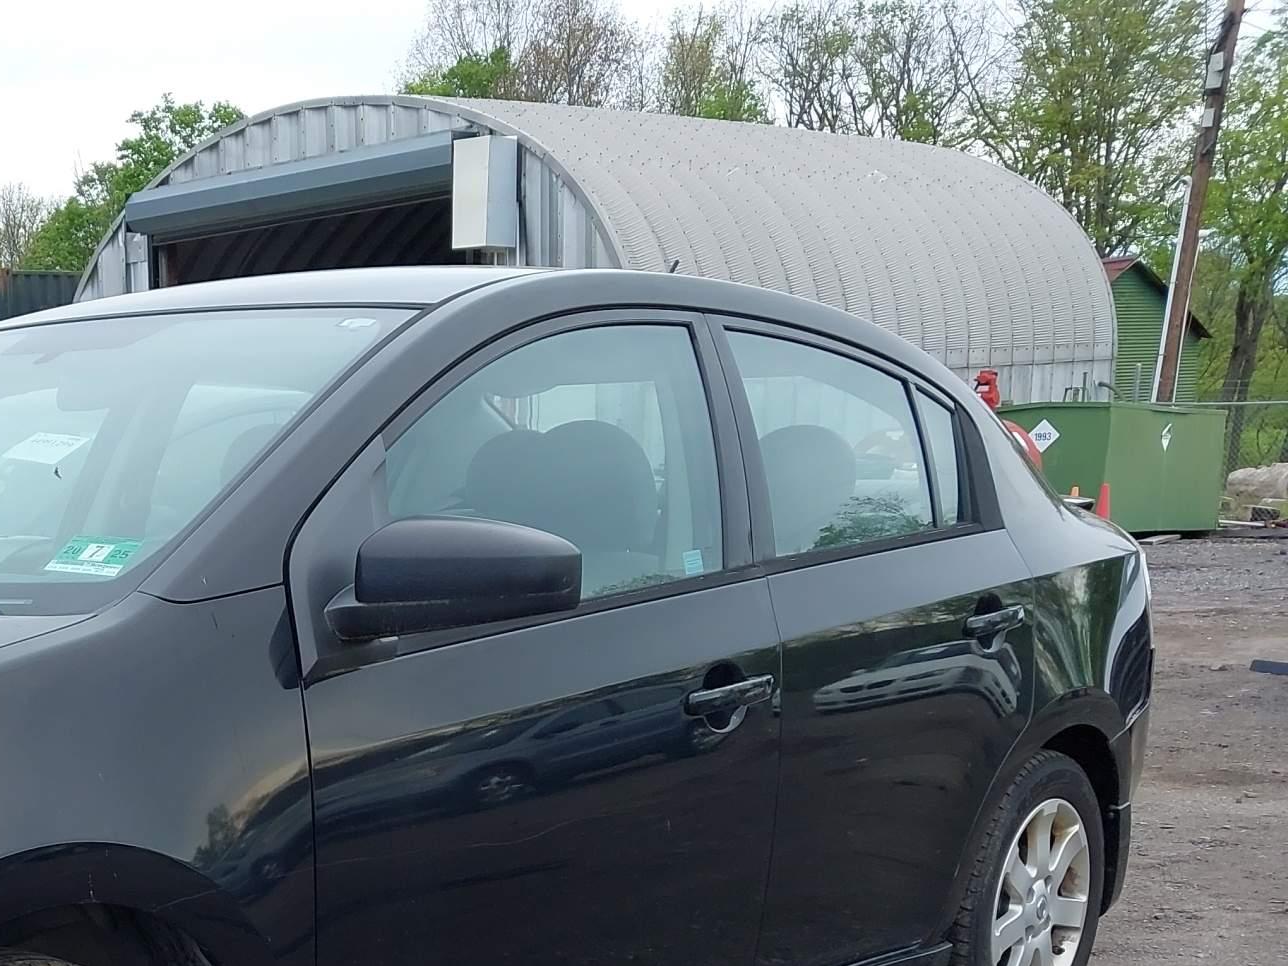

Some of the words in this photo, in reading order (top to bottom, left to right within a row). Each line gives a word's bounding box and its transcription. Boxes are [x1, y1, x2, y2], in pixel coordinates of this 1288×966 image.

[1034, 431, 1052, 441] 1993
[63, 545, 82, 555] 20
[89, 545, 105, 558] 7
[111, 549, 131, 560] 25
